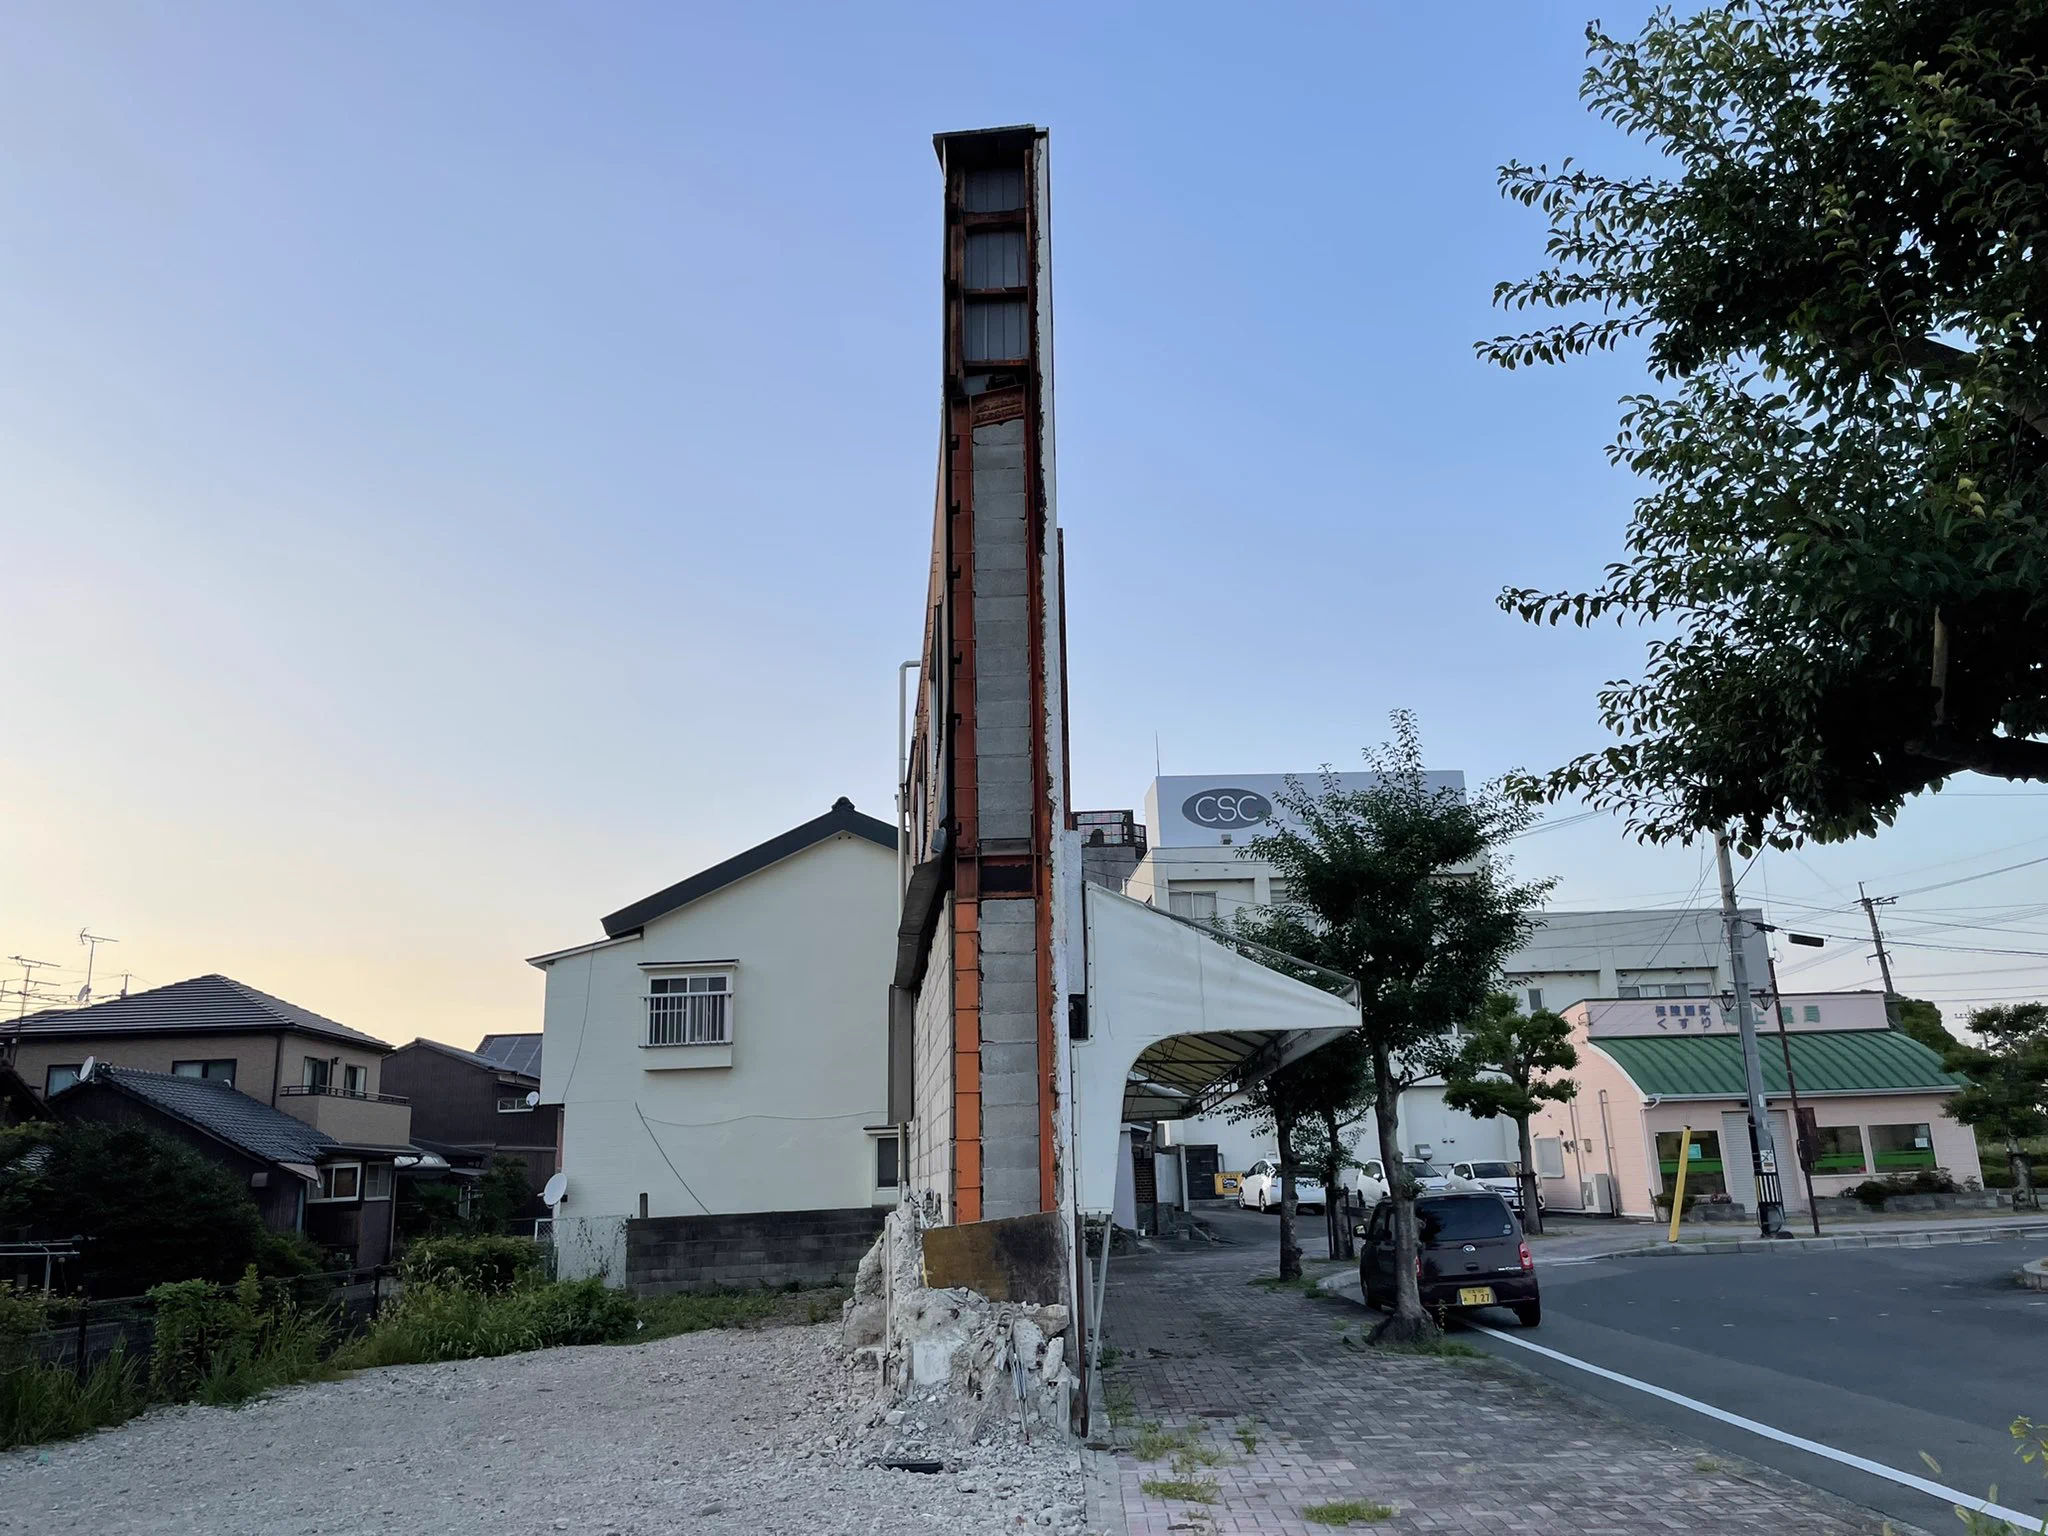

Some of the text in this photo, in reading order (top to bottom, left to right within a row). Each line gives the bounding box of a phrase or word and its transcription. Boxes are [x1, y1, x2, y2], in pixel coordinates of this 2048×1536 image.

[1195, 795, 1259, 822] CSC
[1657, 1017, 1712, 1030] くすり
